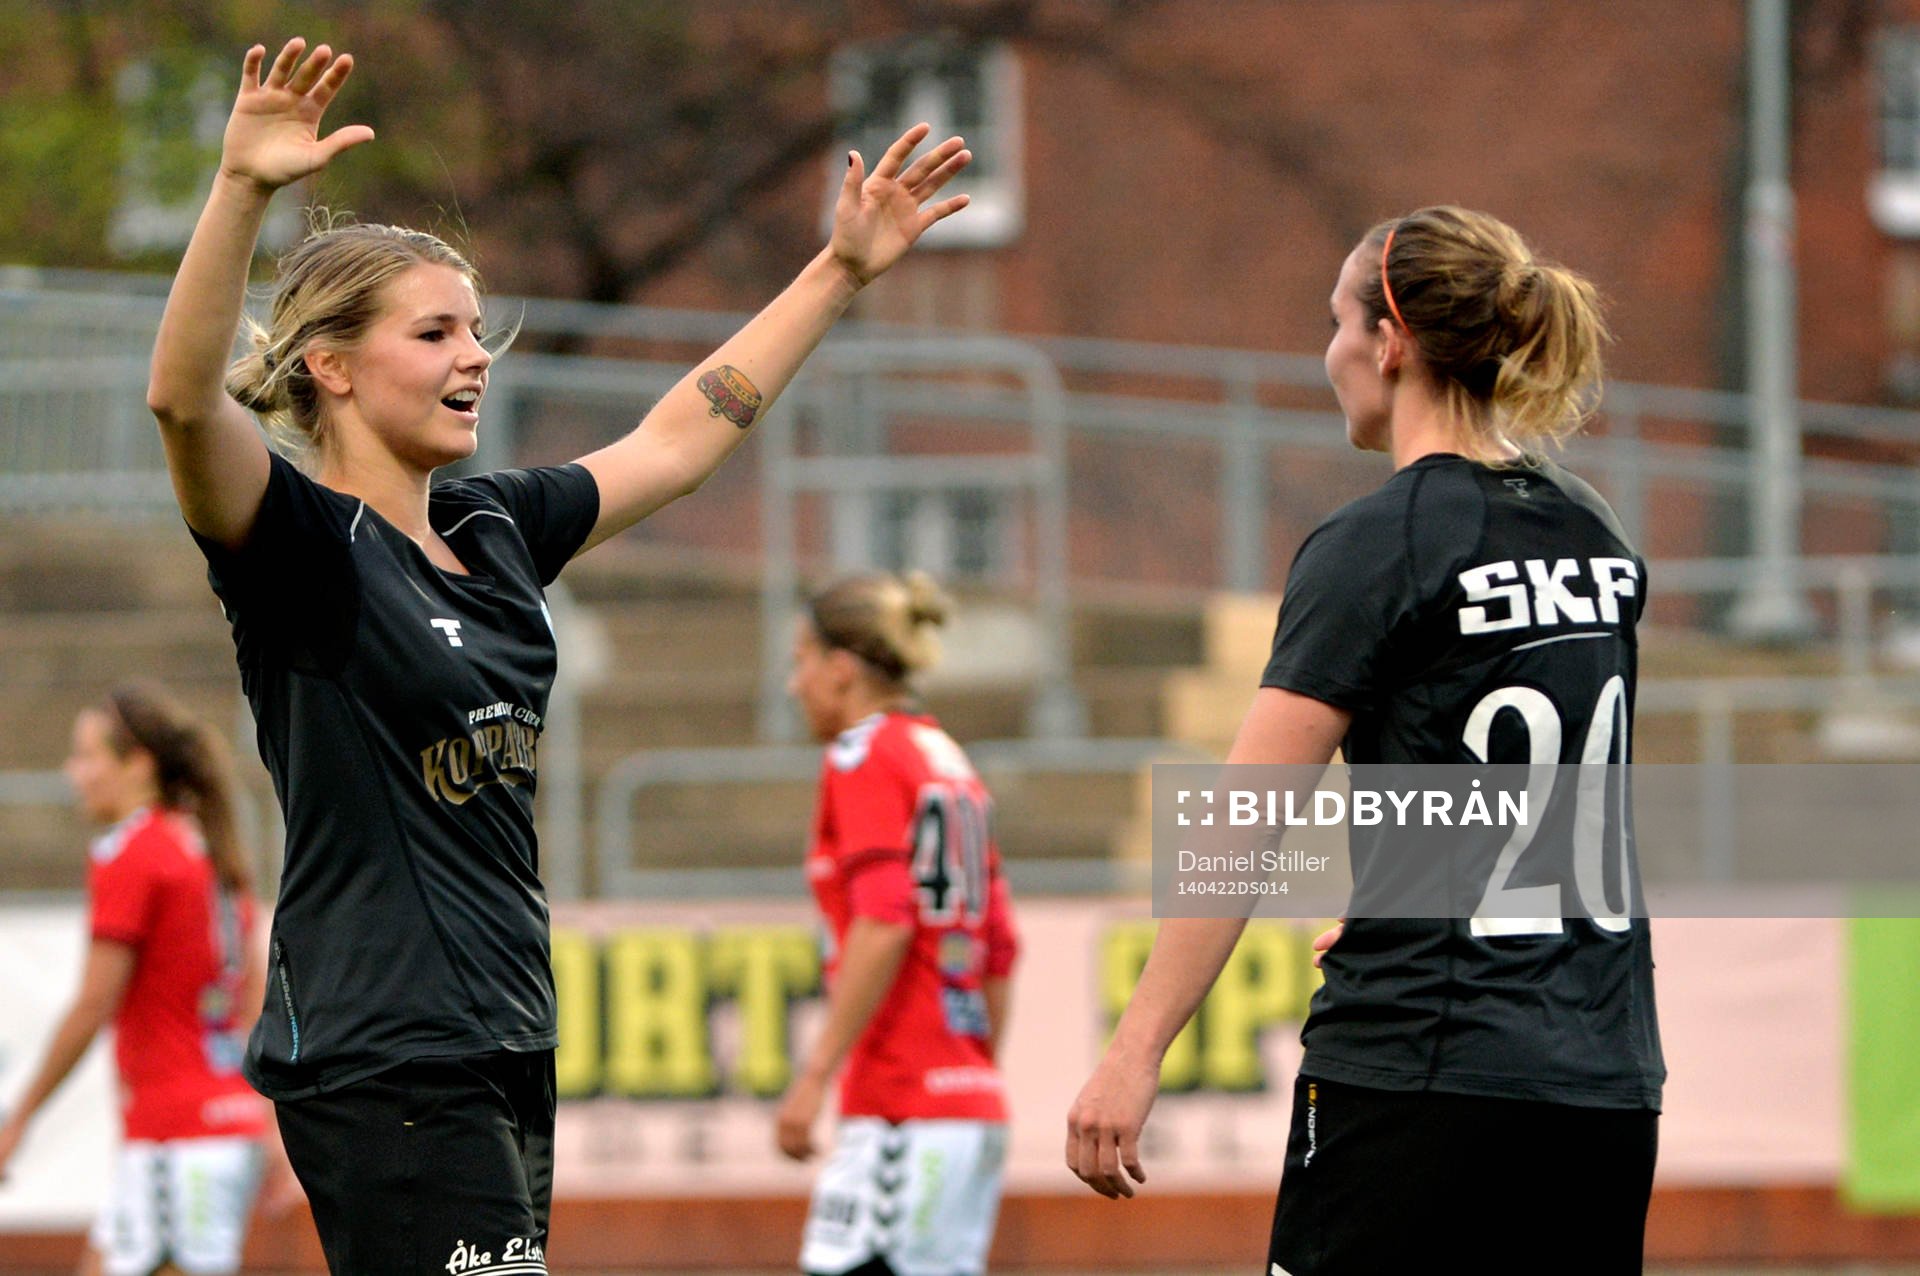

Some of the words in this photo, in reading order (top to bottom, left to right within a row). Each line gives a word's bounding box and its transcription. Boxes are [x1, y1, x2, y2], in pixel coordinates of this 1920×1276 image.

[1457, 557, 1639, 637] SKF
[1462, 673, 1633, 938] 20
[445, 1239, 492, 1275] Åke
